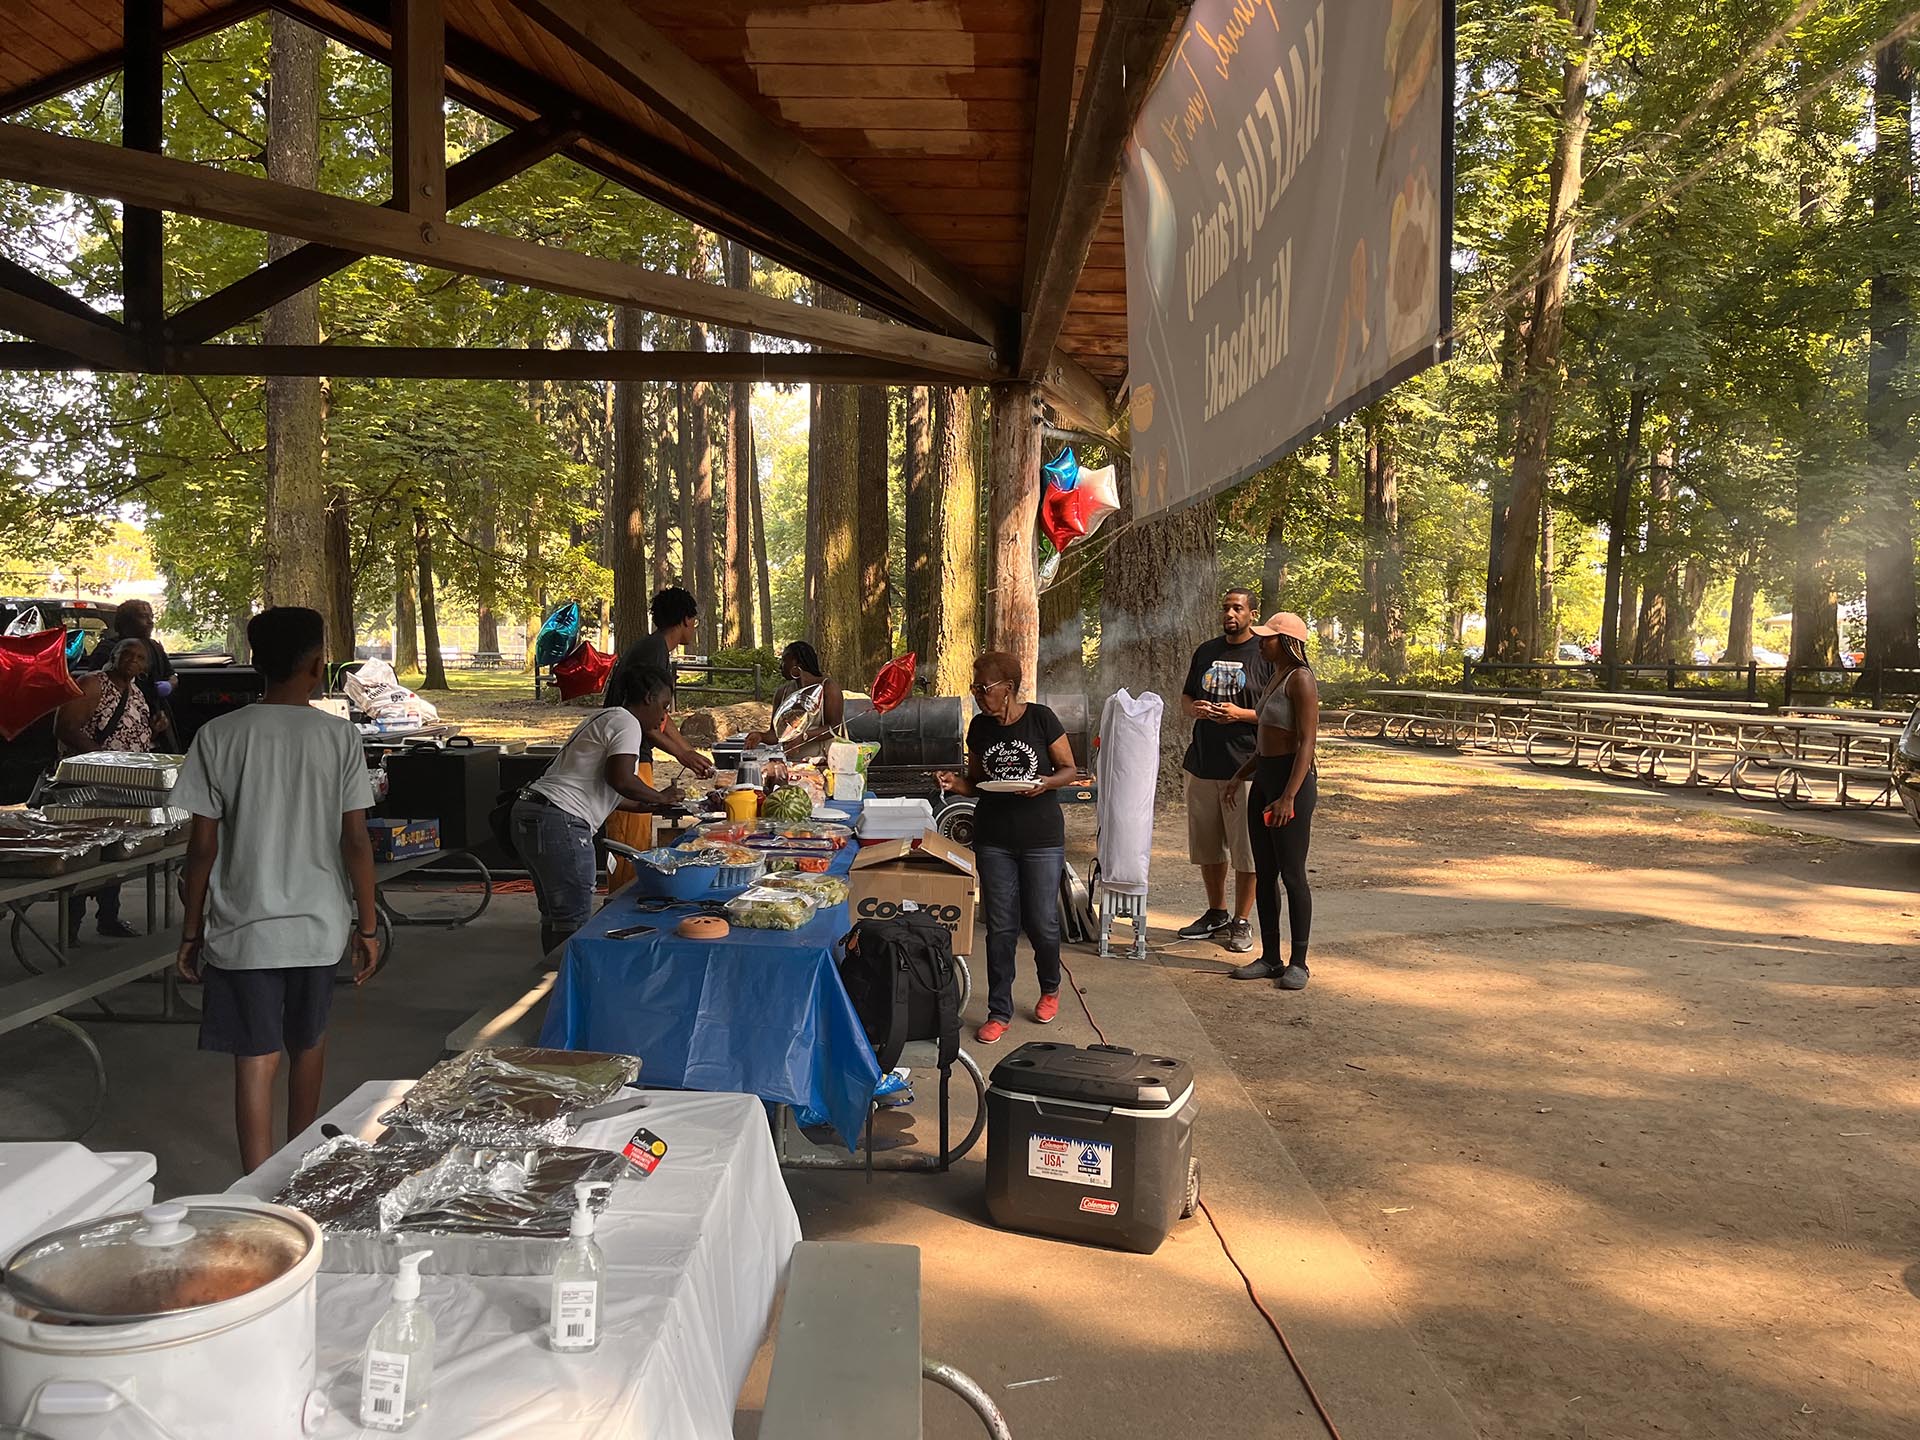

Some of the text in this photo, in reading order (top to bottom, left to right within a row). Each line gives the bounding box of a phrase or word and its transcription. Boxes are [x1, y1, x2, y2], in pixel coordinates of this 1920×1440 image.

[998, 748, 1019, 756] love
[995, 755, 1020, 763] more
[995, 766, 1024, 774] worry
[1087, 1149, 1093, 1160] 5
[1044, 1153, 1062, 1168] USA
[1083, 1199, 1110, 1211] Coleman
